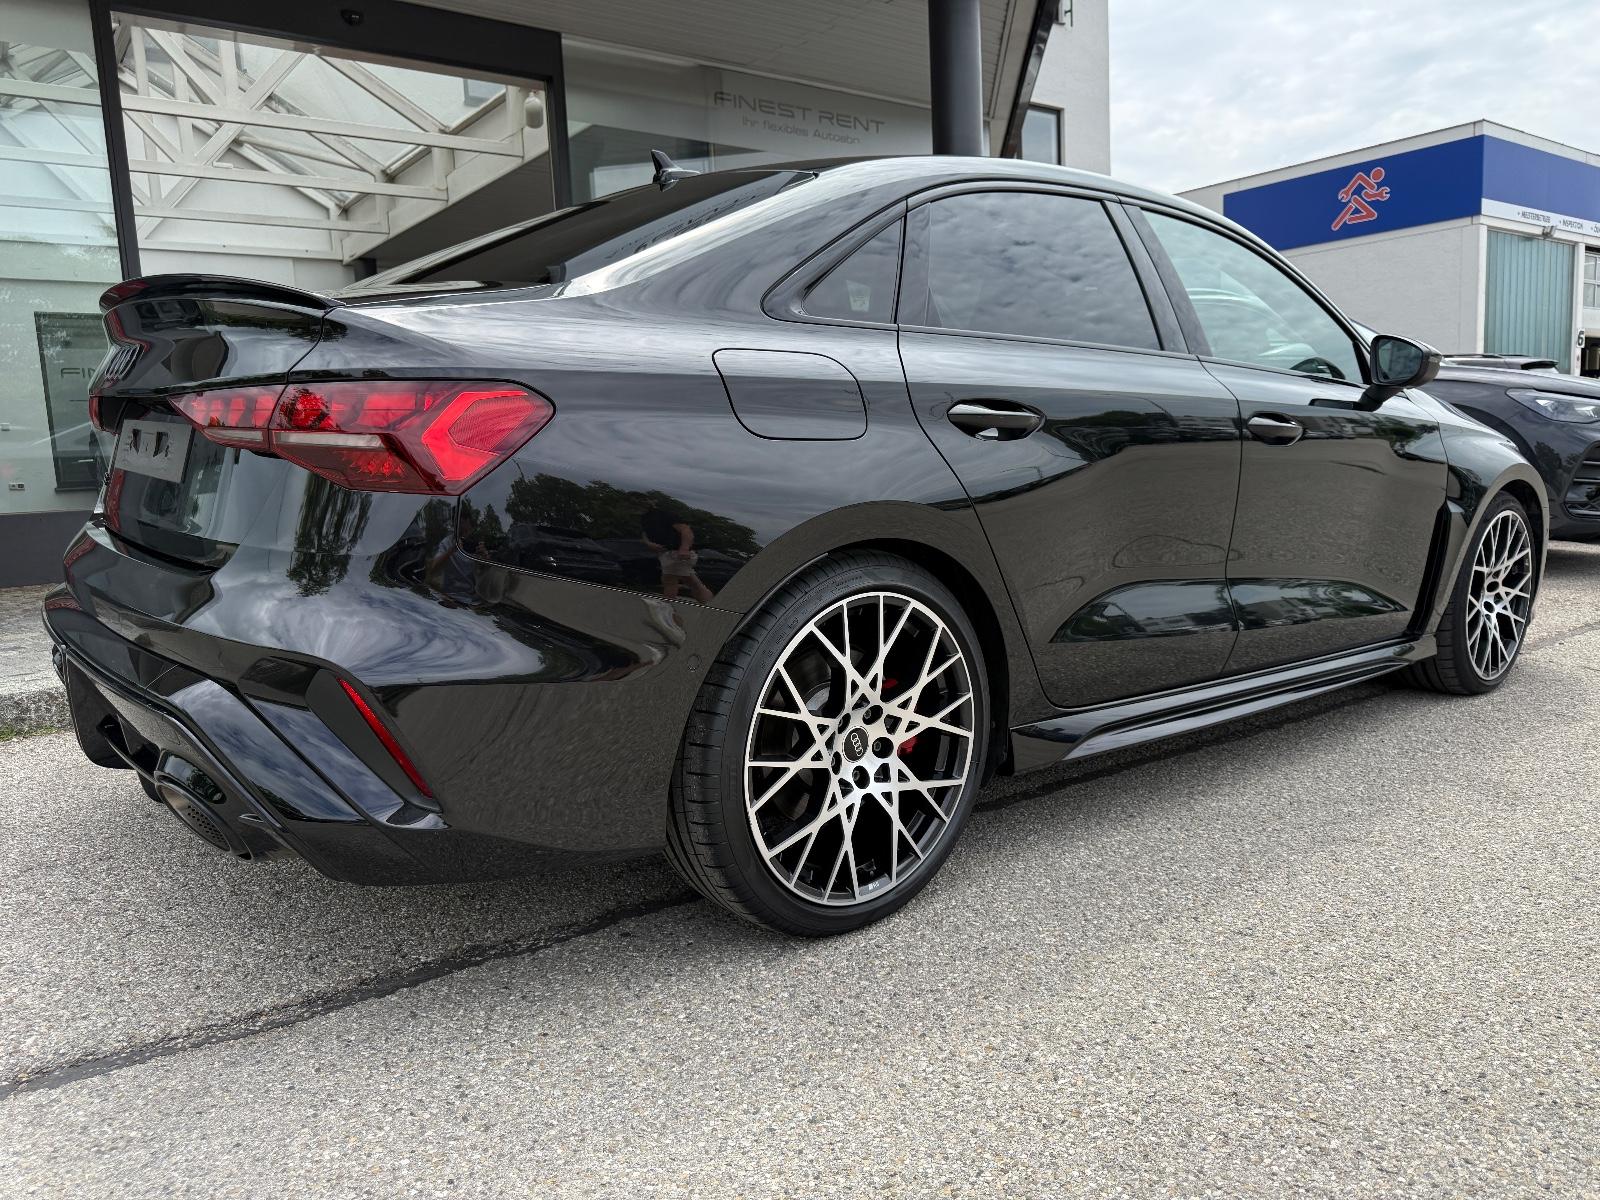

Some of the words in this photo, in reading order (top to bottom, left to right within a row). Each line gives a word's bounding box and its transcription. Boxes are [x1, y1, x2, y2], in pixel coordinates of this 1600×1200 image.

[714, 91, 812, 121] FINEST
[818, 110, 886, 134] RENT
[742, 115, 759, 128] Ihr
[1577, 330, 1585, 347] 6
